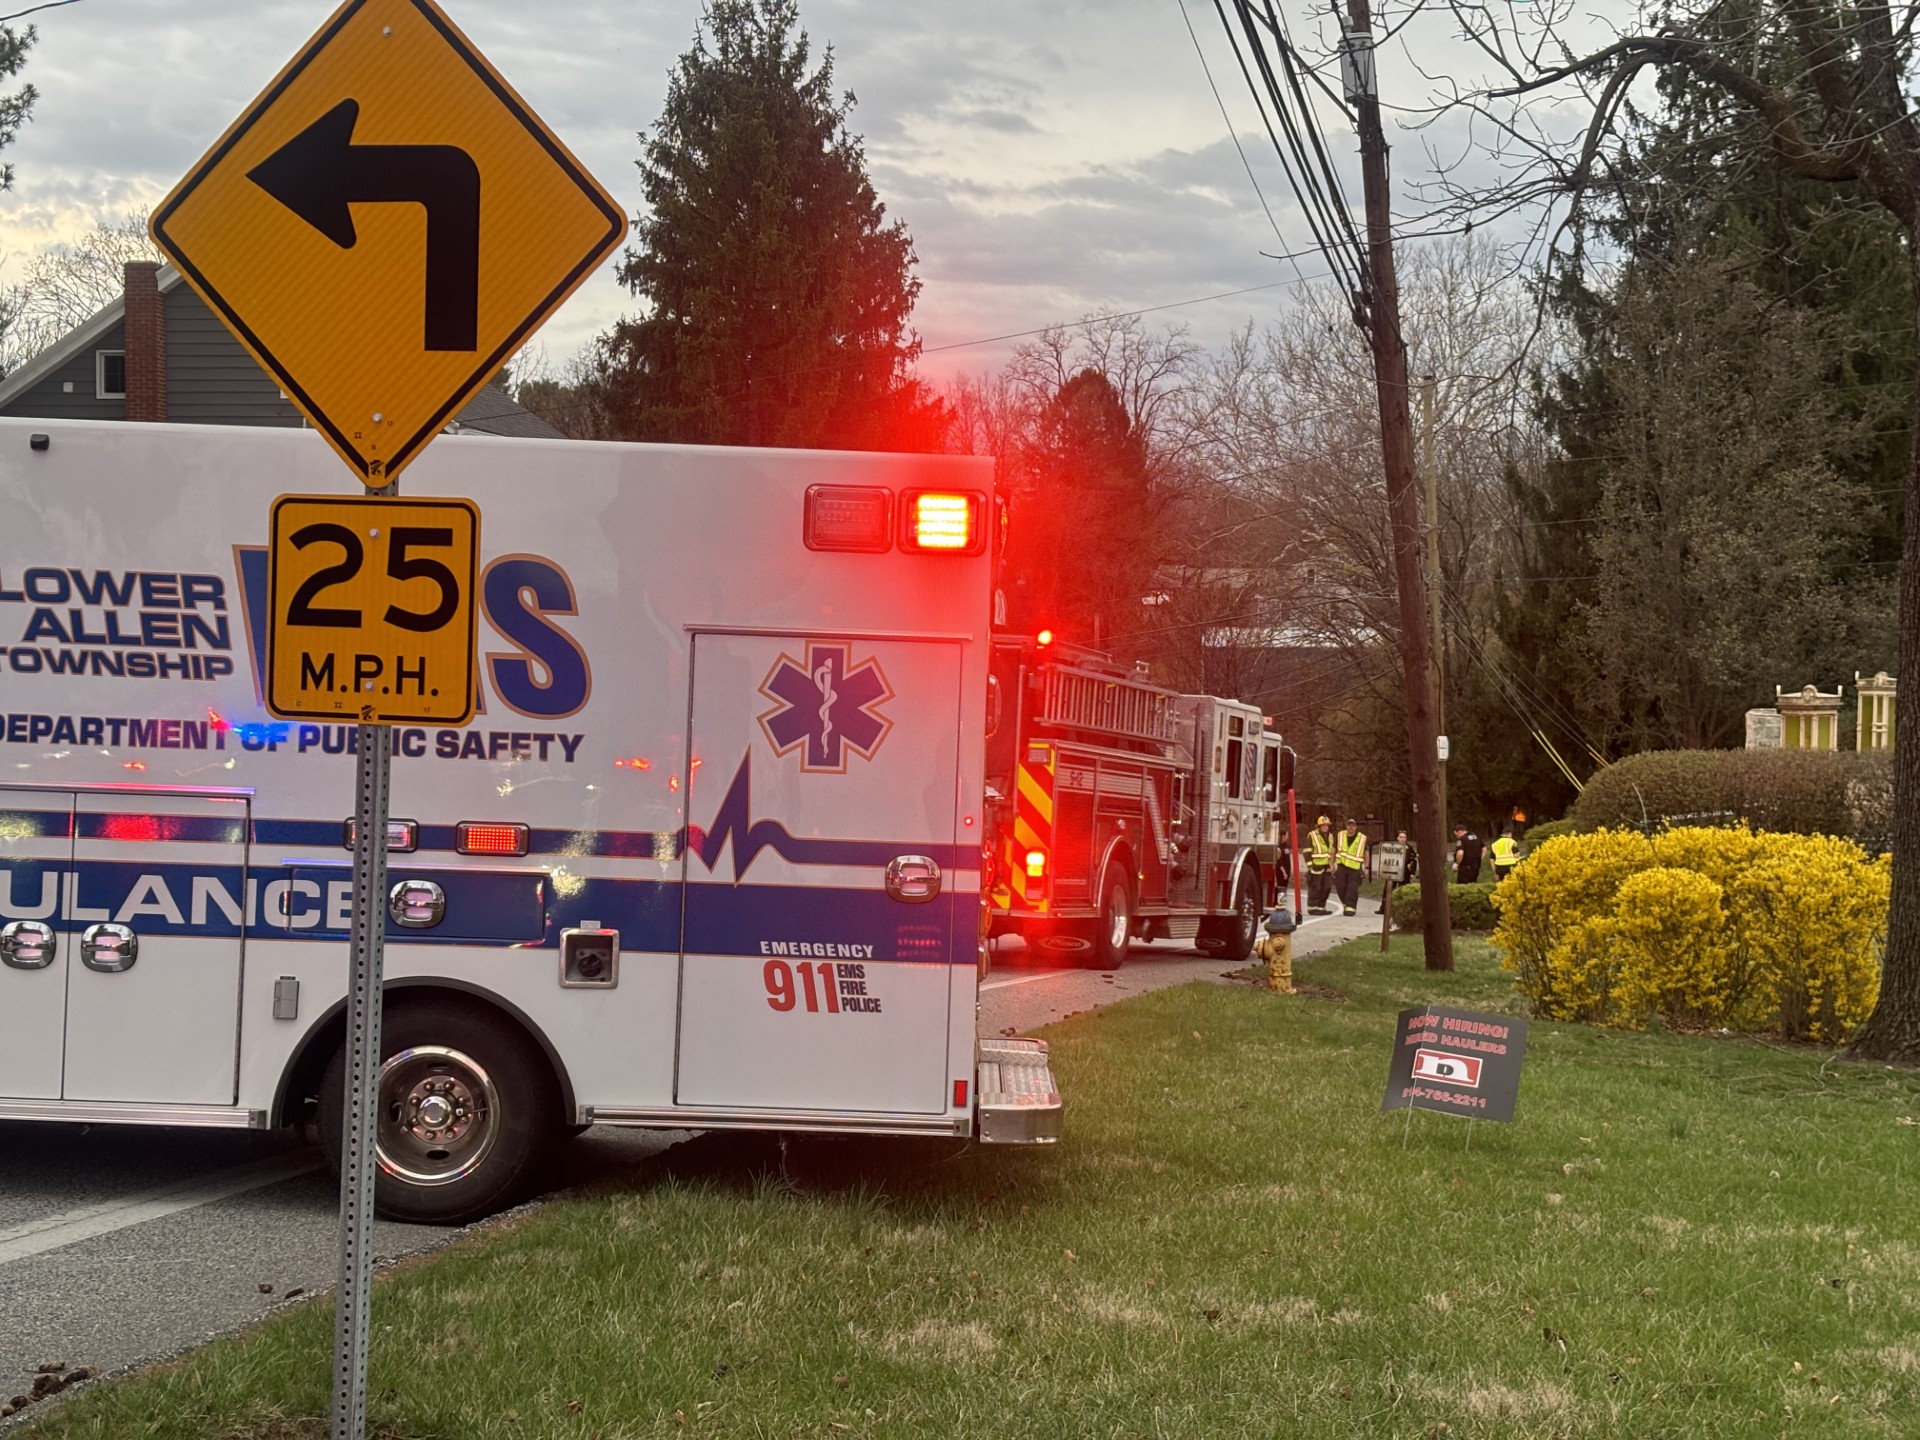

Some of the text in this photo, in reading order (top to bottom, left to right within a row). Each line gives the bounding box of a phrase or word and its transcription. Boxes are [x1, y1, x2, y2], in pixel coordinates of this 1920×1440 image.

[287, 523, 460, 632] 25
[21, 606, 233, 650] ALLEN
[301, 652, 439, 697] M.P.H.
[0, 714, 584, 763] EPARTMENT OF PUBIC SAFETY
[1382, 846, 1404, 856] PARKING
[1383, 858, 1400, 867] AREA
[760, 941, 873, 958] EMERGENCY
[836, 963, 865, 979] EMS
[763, 959, 840, 1014] 911
[839, 980, 868, 996] FIRE
[841, 996, 882, 1013] POLICE
[1409, 1015, 1509, 1039] NOW HIRING!
[1441, 1035, 1507, 1055] HAULERS
